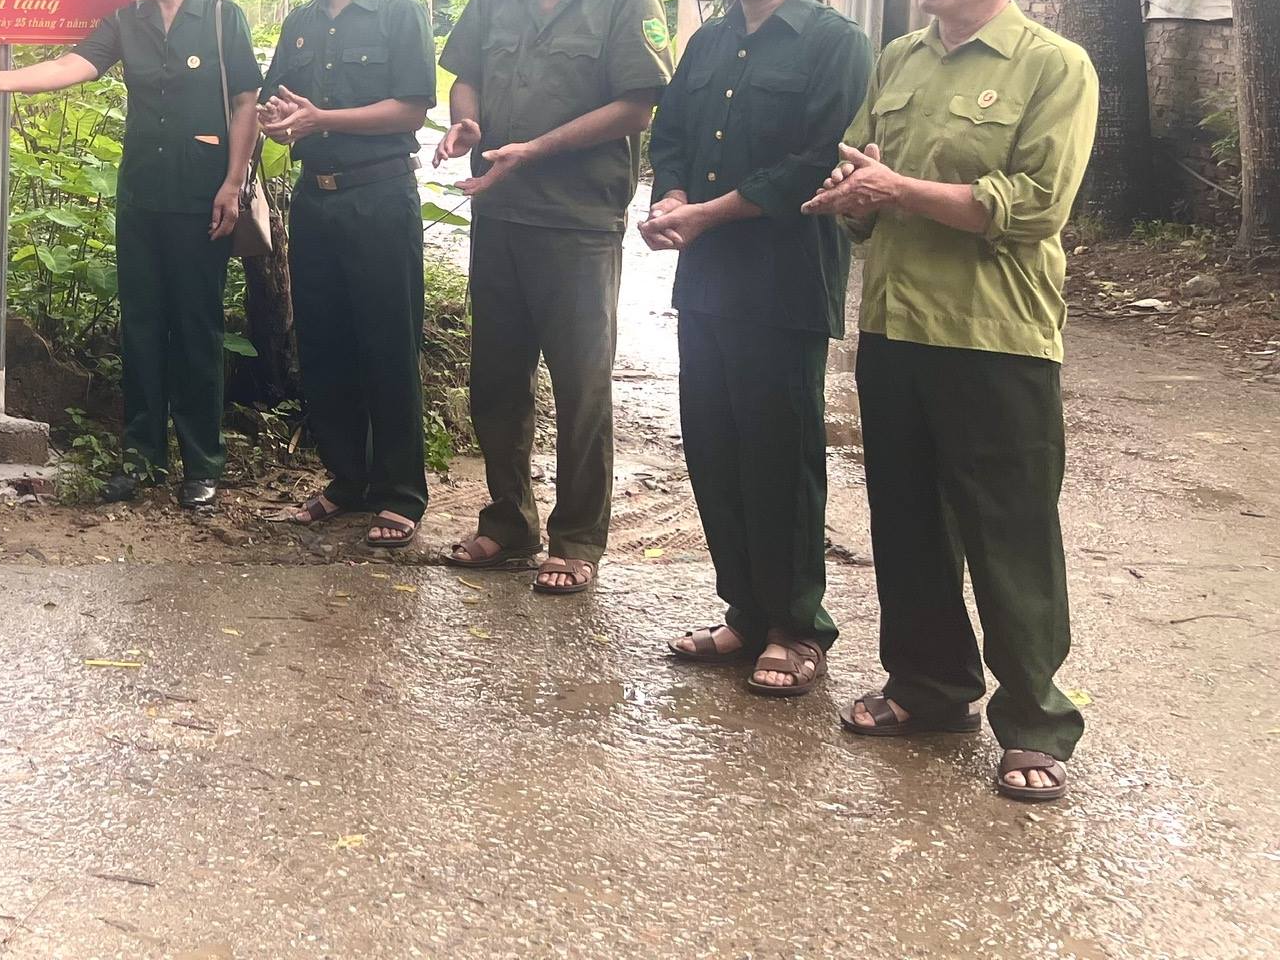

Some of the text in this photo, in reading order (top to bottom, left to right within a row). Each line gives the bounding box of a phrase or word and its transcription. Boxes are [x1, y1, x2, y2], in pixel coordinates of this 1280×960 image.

[28, 18, 56, 29] tháng
[59, 19, 65, 28] 7
[66, 19, 88, 28] năm
